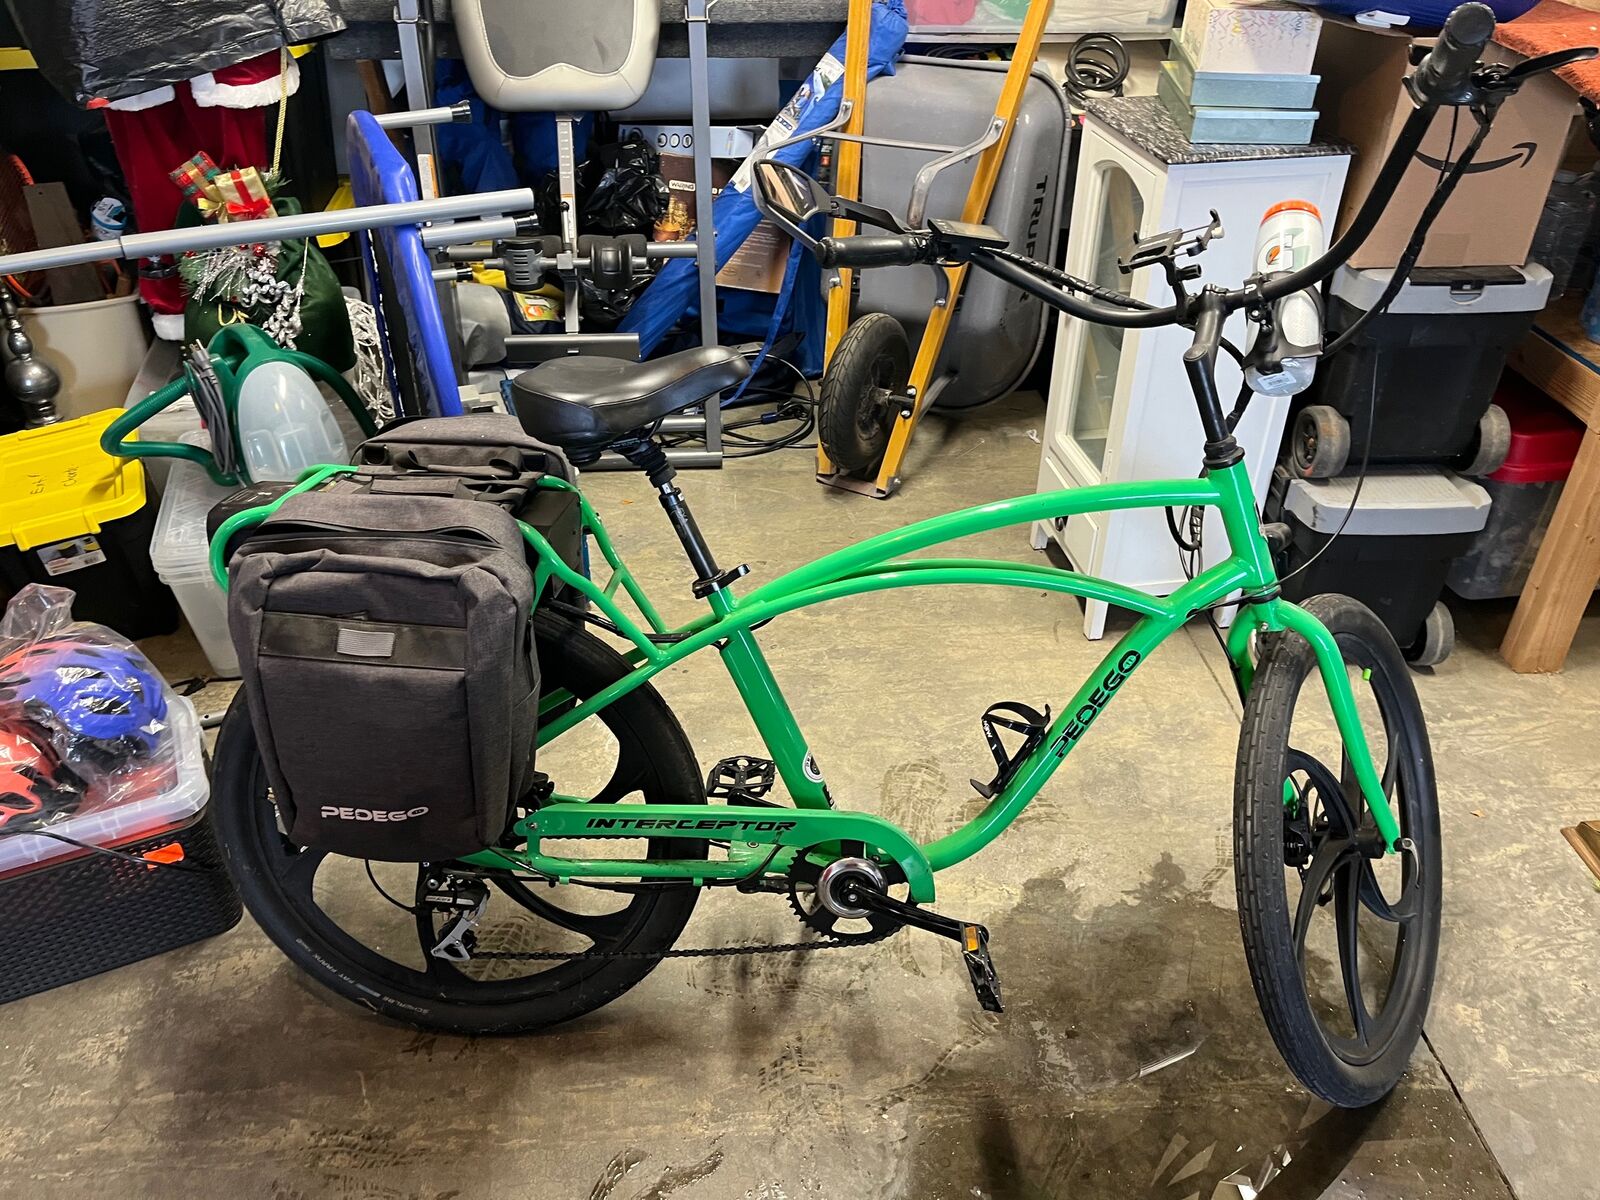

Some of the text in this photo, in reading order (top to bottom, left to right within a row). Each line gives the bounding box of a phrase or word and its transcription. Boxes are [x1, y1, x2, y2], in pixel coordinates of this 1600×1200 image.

[671, 181, 695, 191] WARING
[1049, 649, 1141, 758] PEDEGO
[320, 805, 429, 822] PEDEGO
[585, 817, 798, 832] INTERCEPTOR
